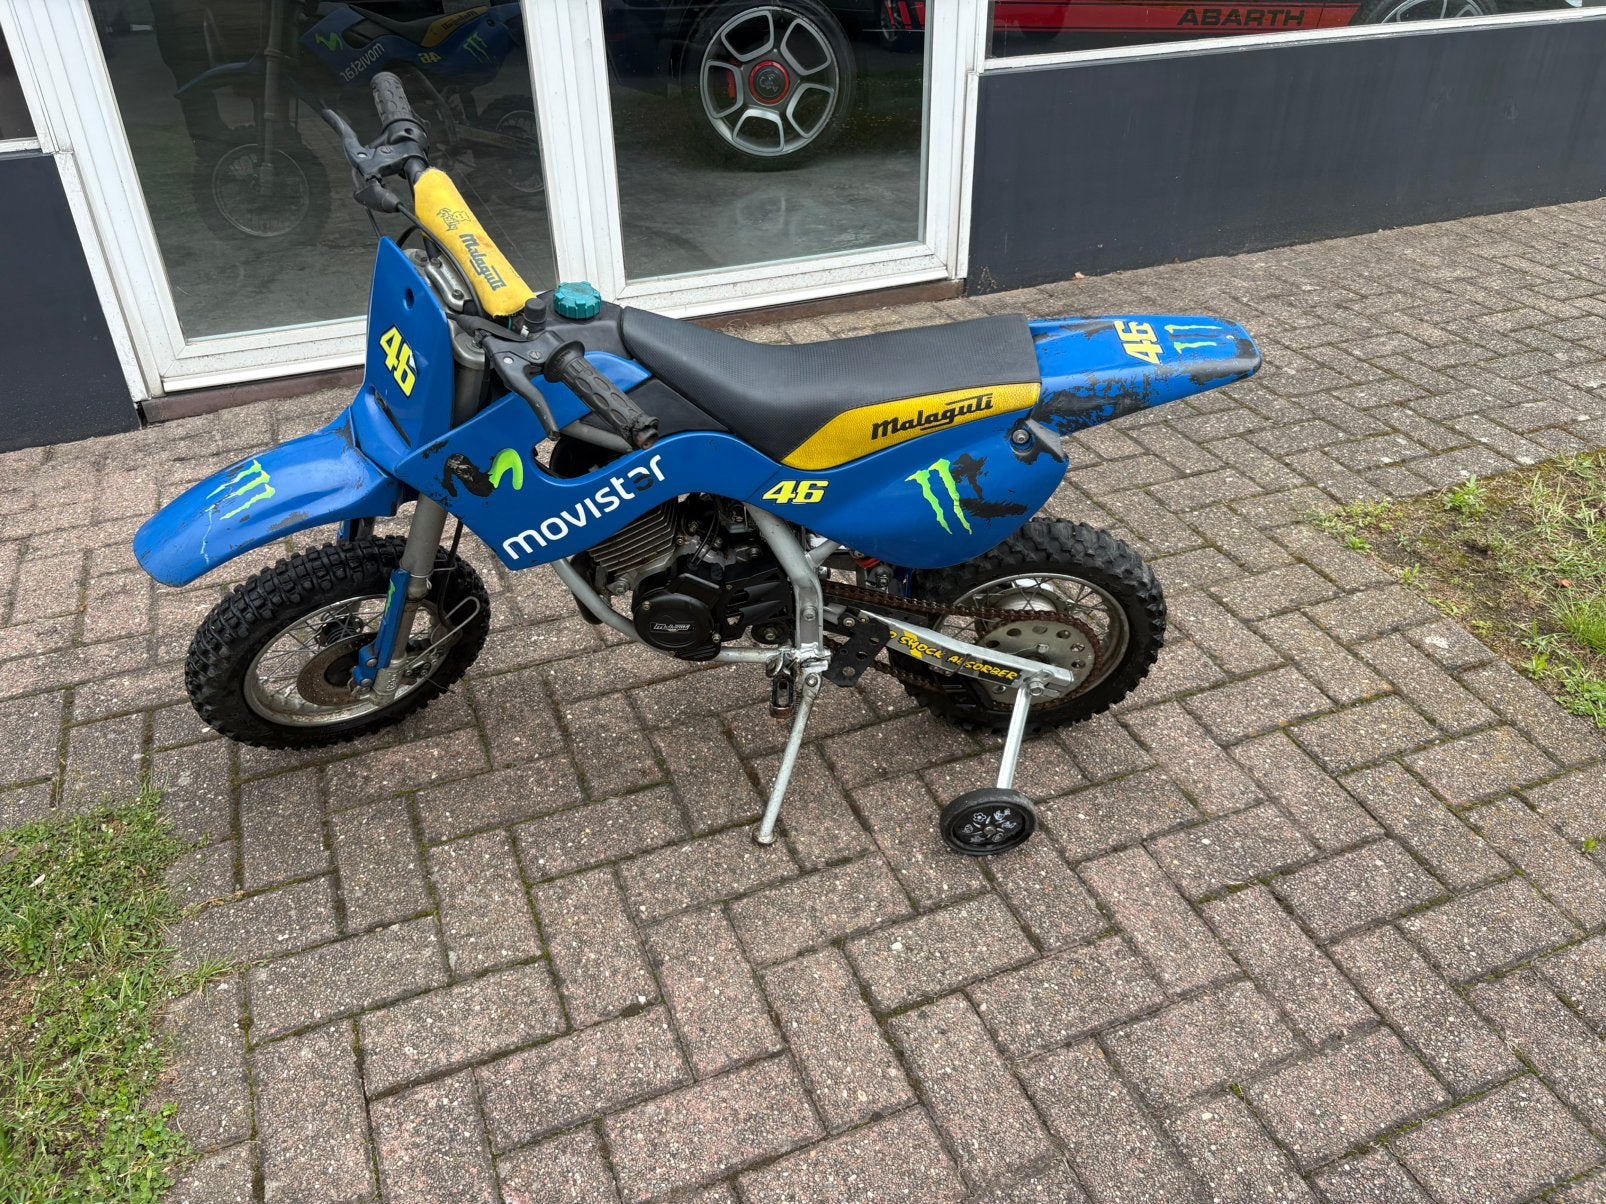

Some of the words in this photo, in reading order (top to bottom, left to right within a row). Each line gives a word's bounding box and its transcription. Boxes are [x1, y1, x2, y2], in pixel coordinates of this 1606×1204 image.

[1177, 9, 1305, 27] ABARTH
[458, 233, 507, 291] Malaguti
[380, 326, 416, 397] 46
[1113, 320, 1165, 365] 46
[870, 393, 994, 441] Malaguti
[502, 454, 668, 559] movistar
[762, 480, 829, 504] 46
[898, 635, 944, 659] SHOCK
